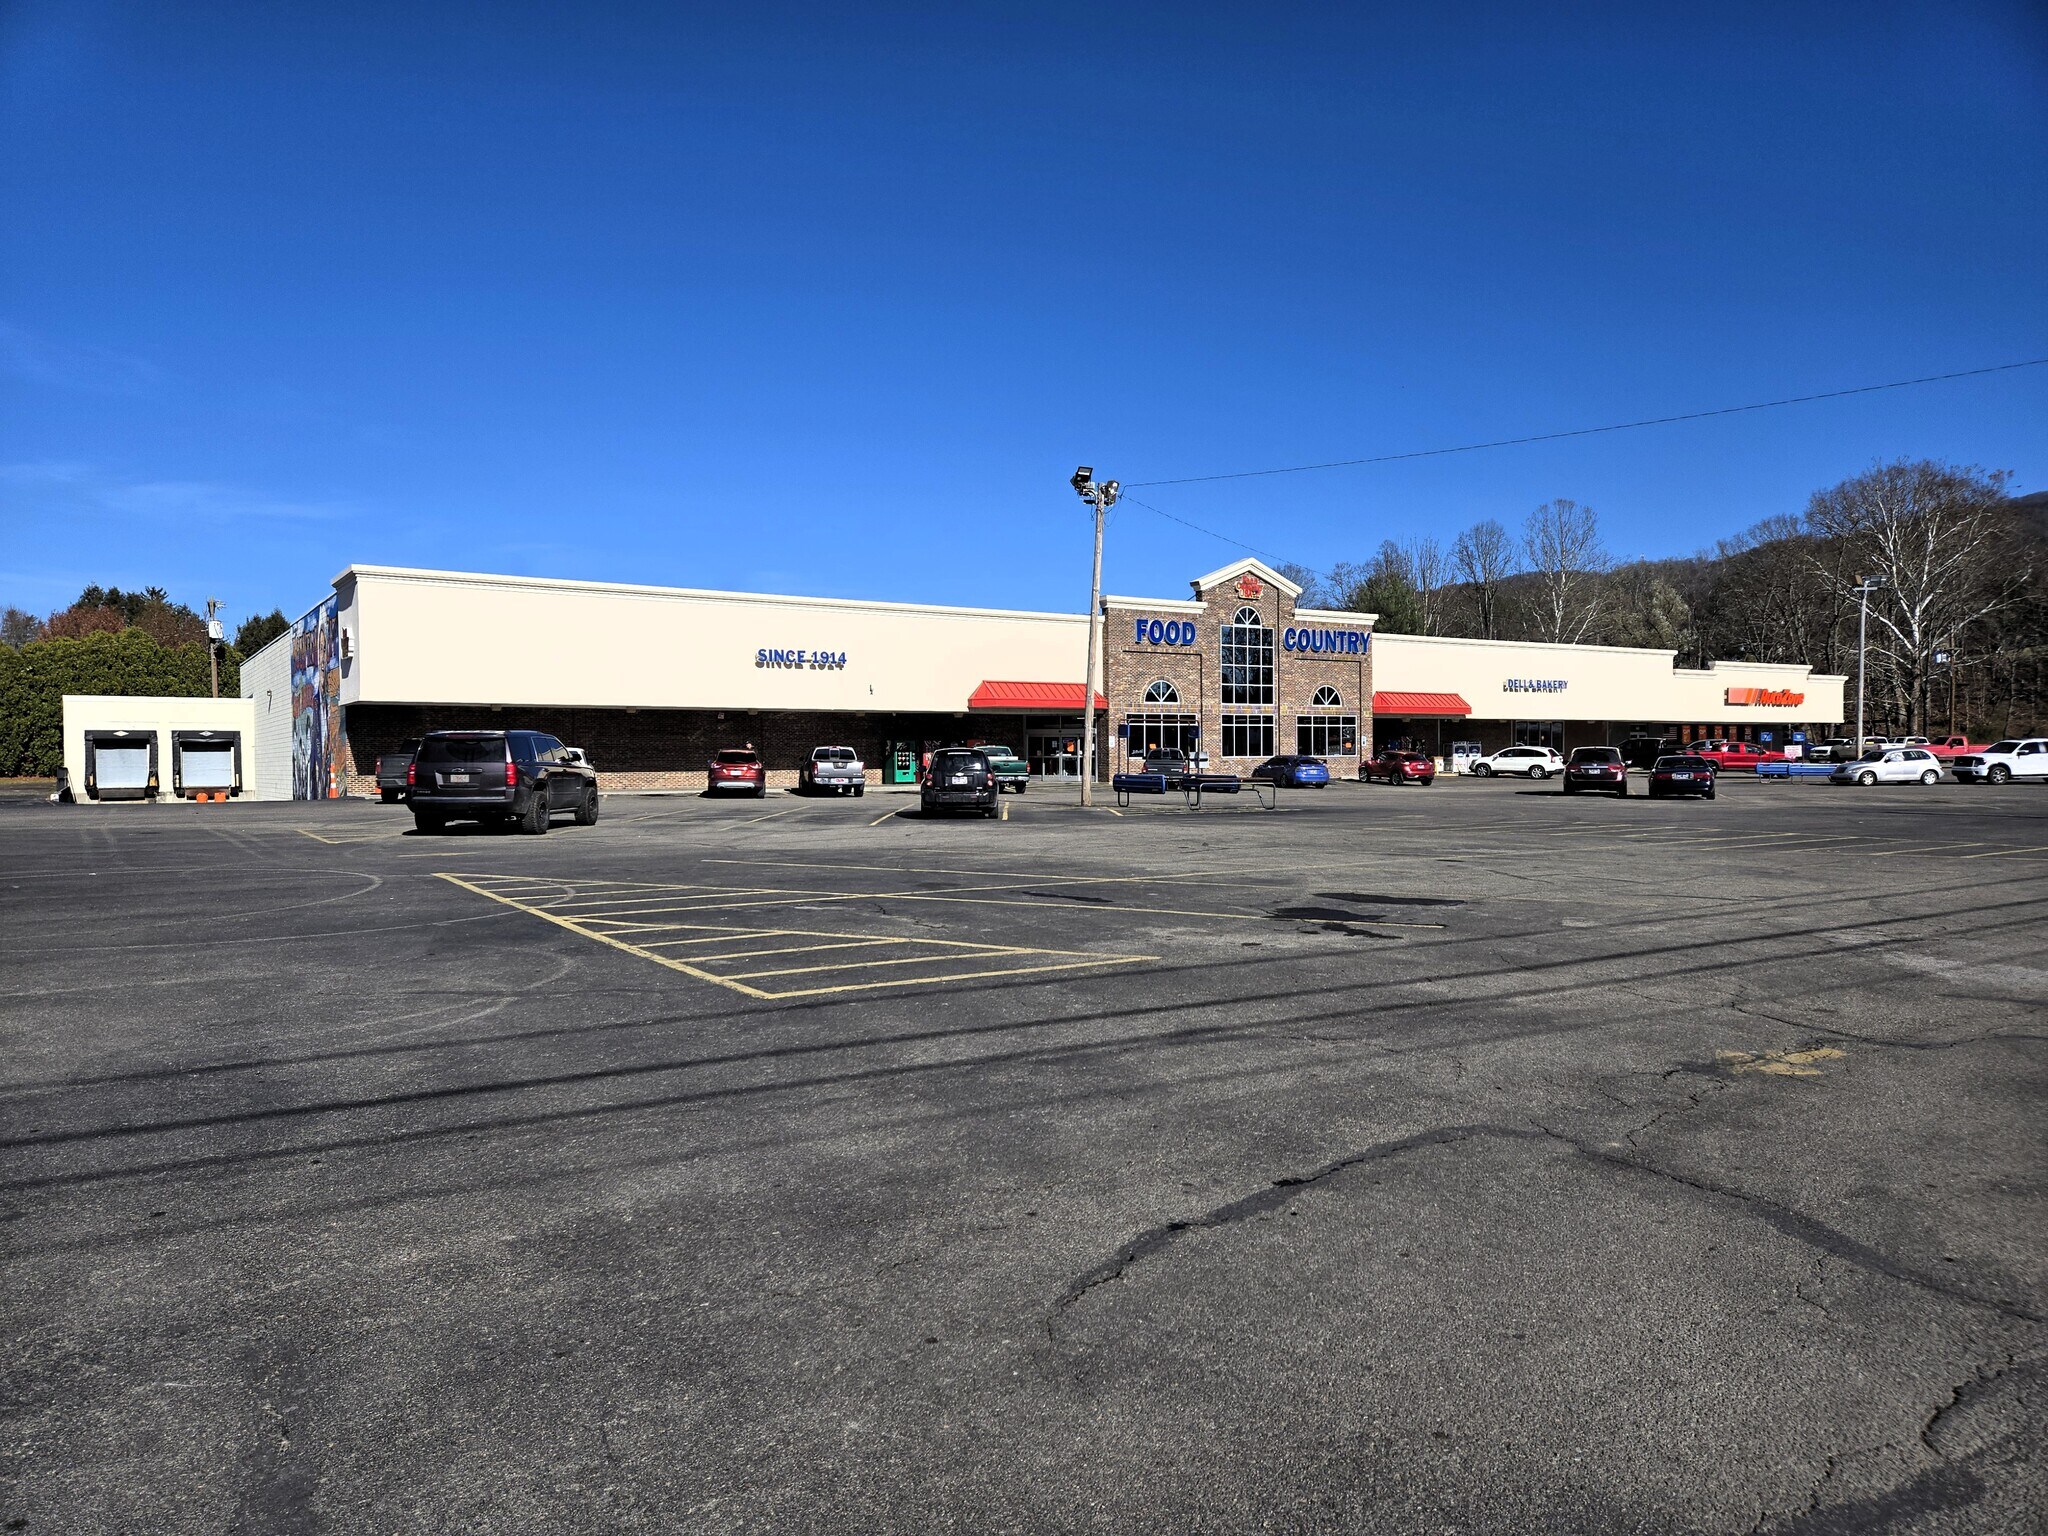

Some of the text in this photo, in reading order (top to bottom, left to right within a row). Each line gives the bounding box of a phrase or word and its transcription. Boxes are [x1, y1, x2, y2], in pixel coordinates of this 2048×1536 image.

[1135, 619, 1371, 653] FOOD COUNTRY
[757, 649, 847, 664] SINCE 1914
[1507, 679, 1569, 690] DELI & BAKERY
[1760, 688, 1805, 705] AutoZone
